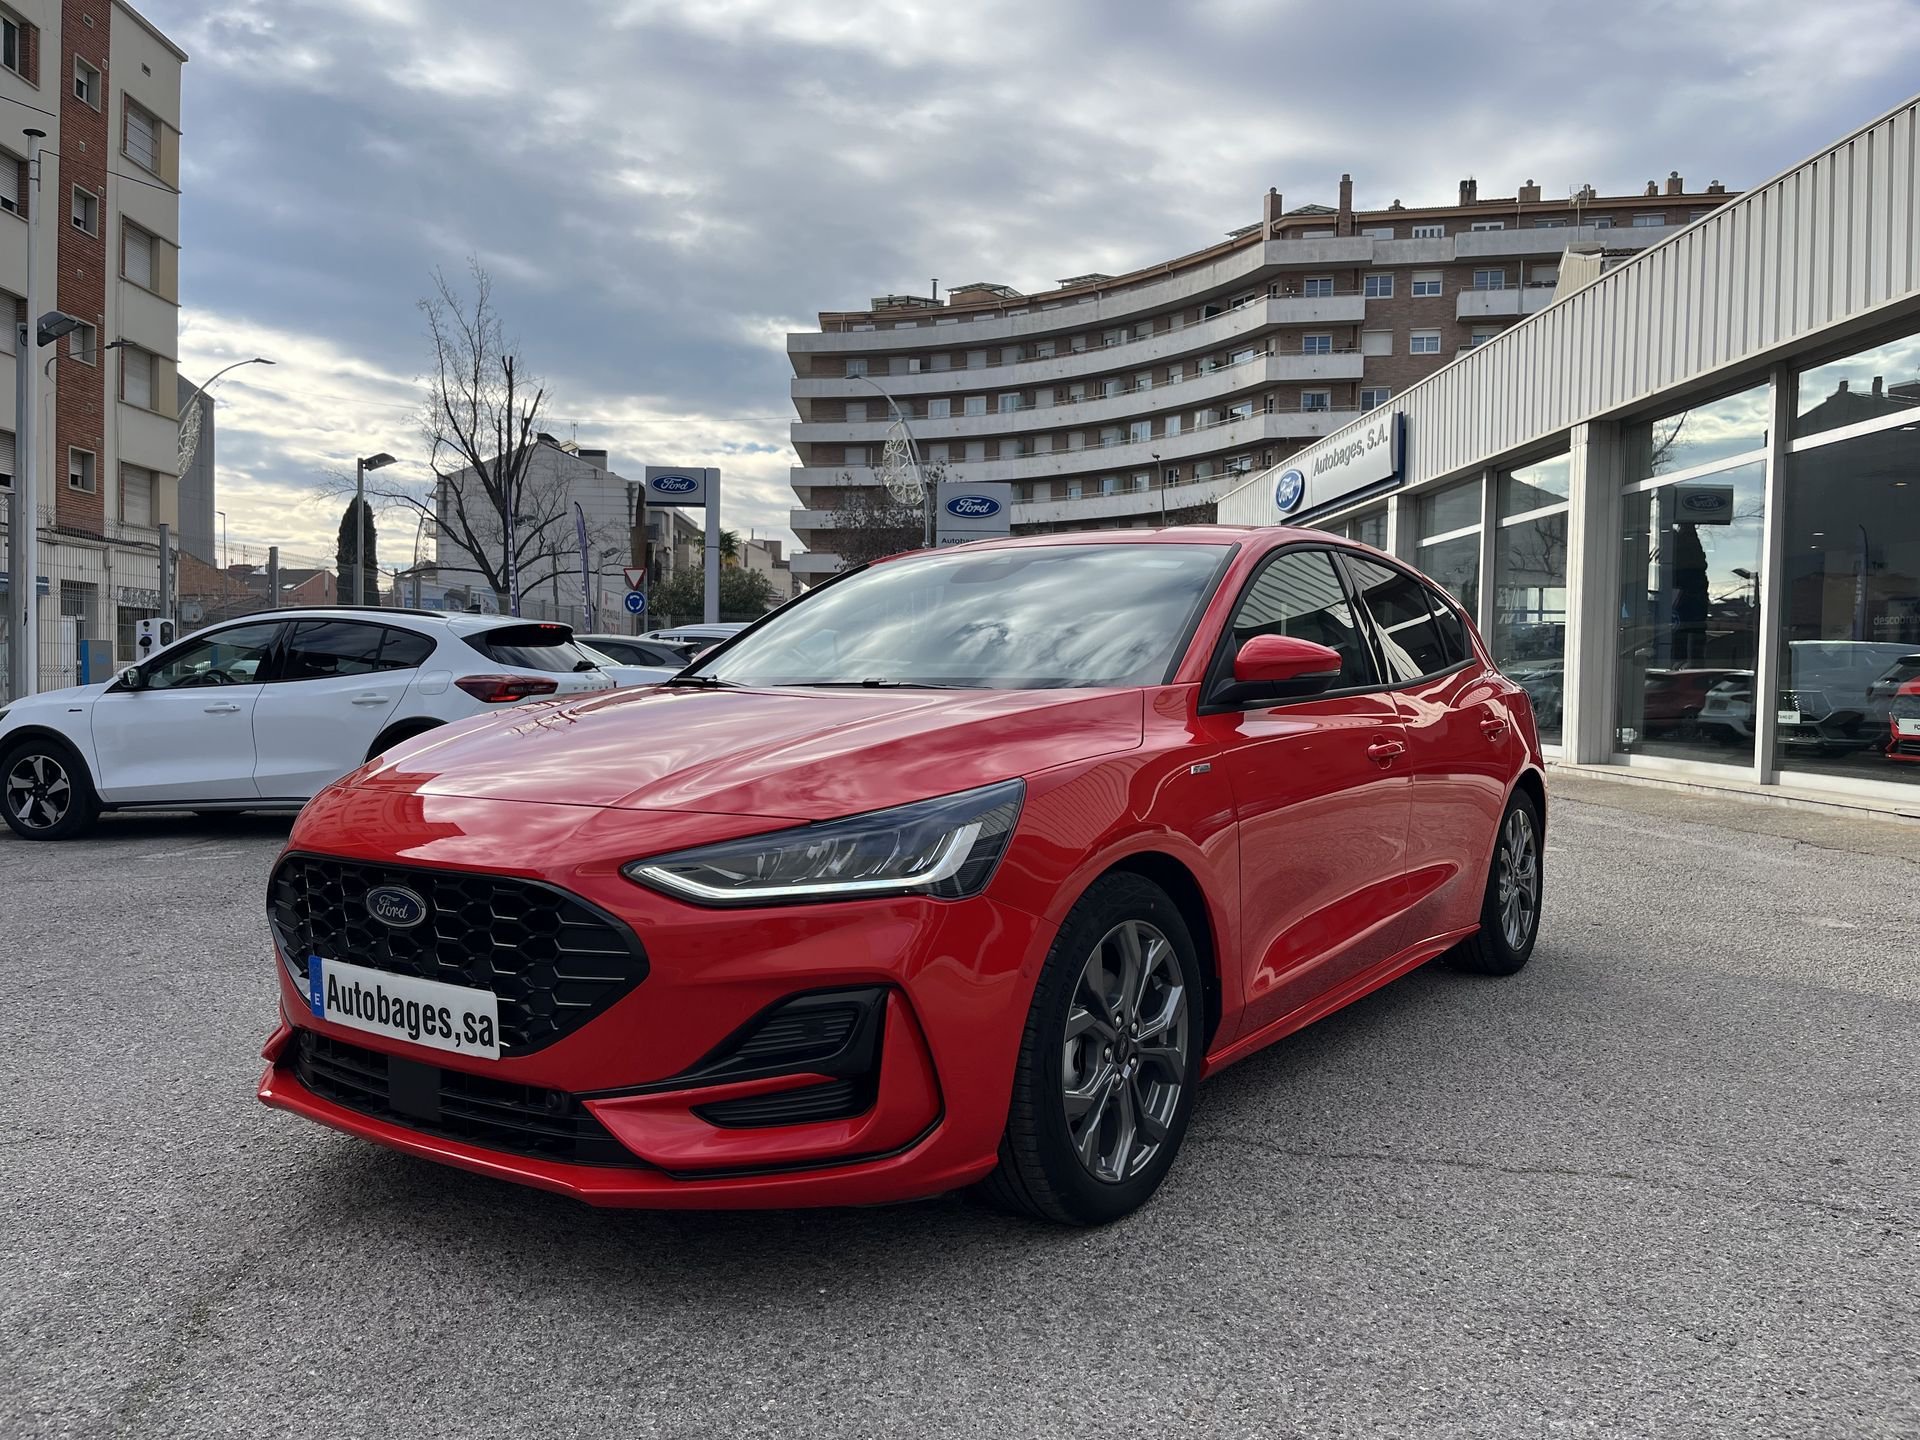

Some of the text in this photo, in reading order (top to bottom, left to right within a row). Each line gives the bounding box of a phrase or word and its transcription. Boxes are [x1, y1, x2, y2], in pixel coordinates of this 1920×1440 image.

[1313, 423, 1388, 477] Autobages, S.A.
[661, 477, 689, 490] Ford
[956, 498, 991, 513] Ford
[376, 894, 409, 919] Ford
[314, 992, 321, 1006] E
[327, 973, 495, 1048] Autobages,sa
